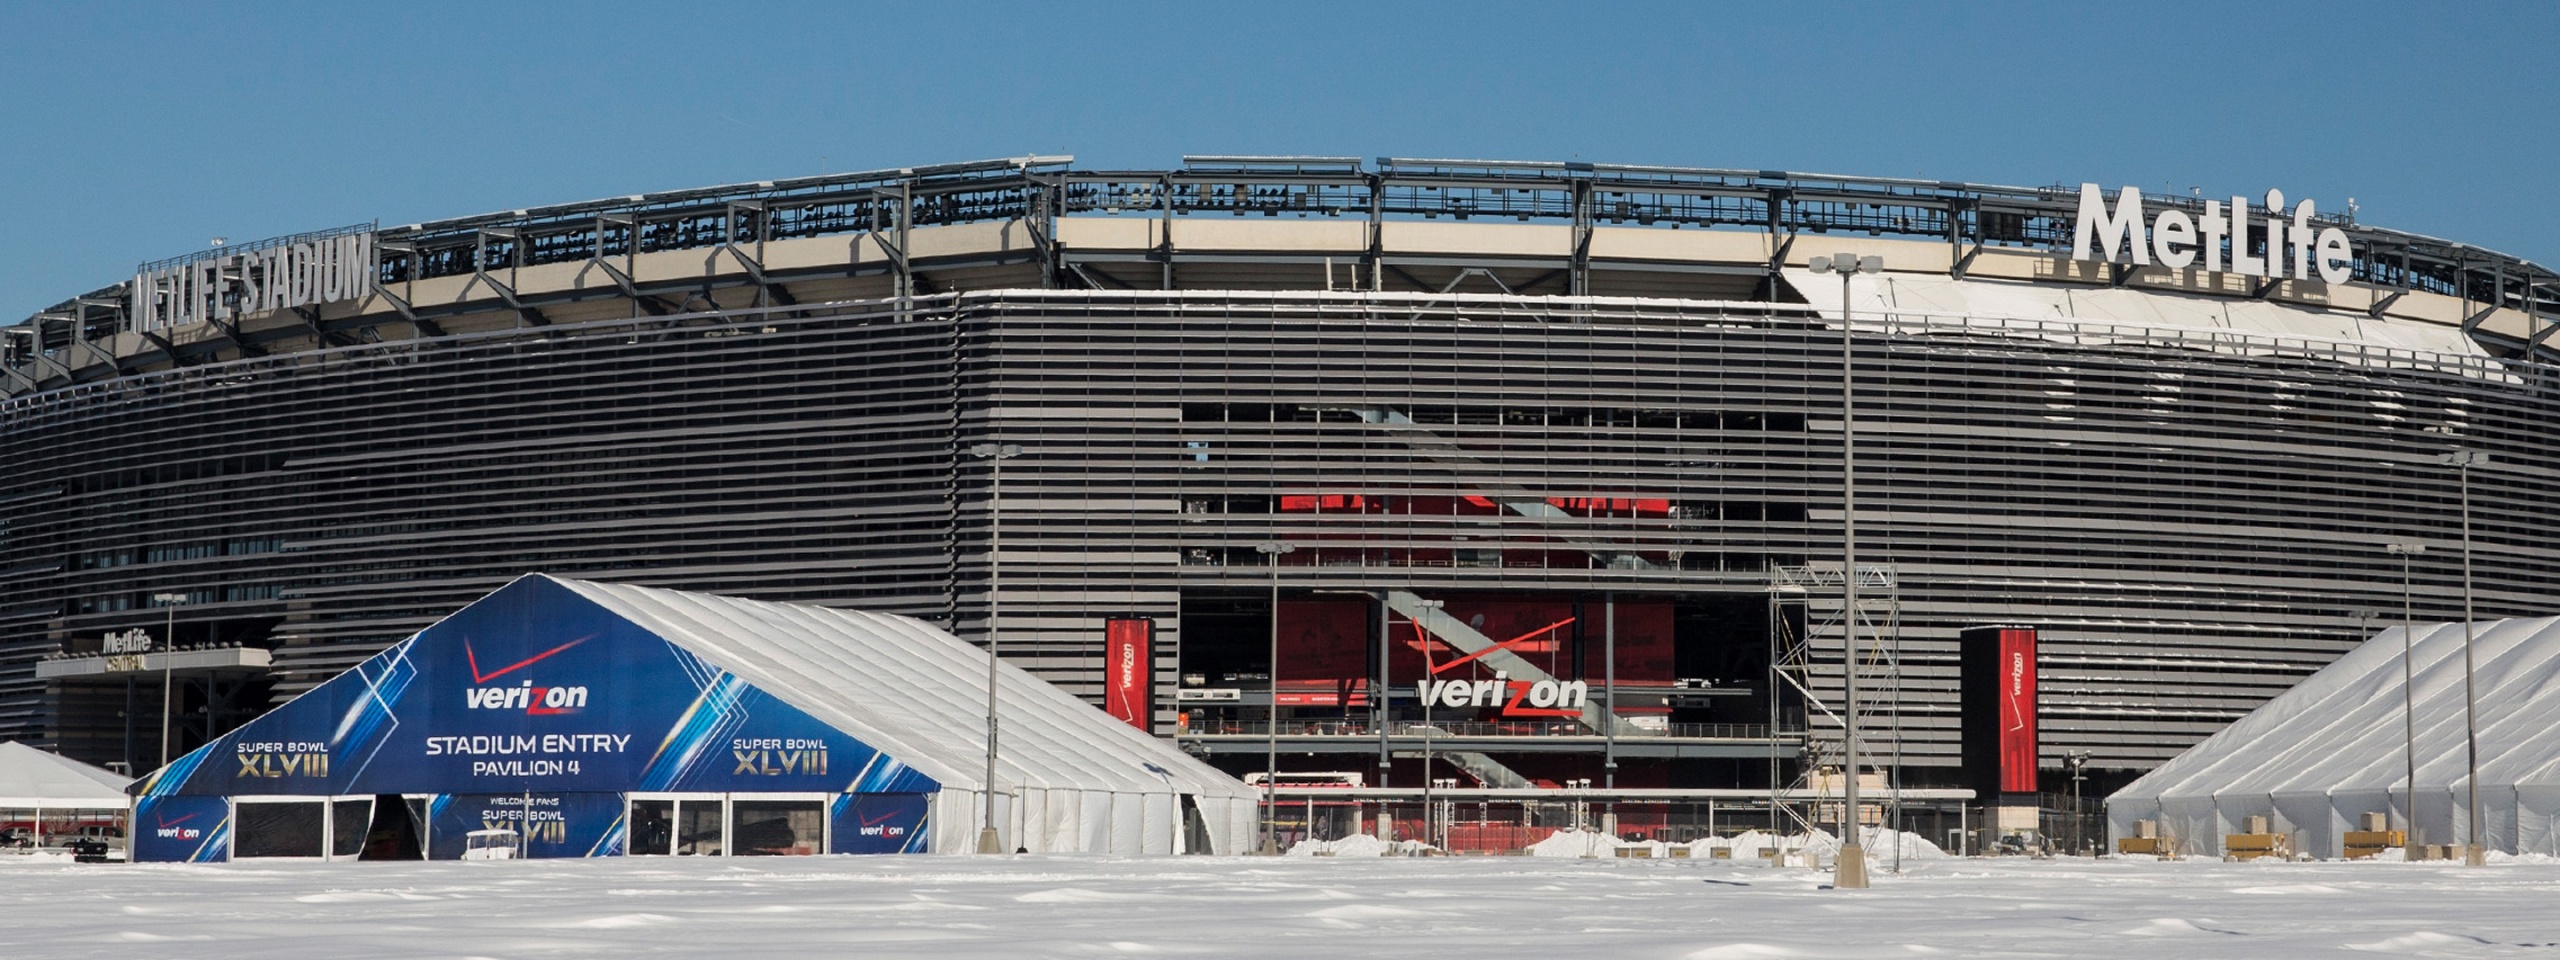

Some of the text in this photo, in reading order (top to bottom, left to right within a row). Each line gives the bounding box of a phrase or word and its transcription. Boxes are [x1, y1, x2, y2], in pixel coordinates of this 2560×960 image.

[2072, 182, 2353, 286] MetLife
[131, 232, 371, 335] METLIFE STADIUM
[103, 628, 151, 653] MetLife
[1123, 643, 1134, 689] verizon
[2011, 652, 2024, 696] verizon
[466, 679, 588, 715] verizon
[1417, 670, 1588, 716] verizon
[237, 742, 329, 753] SUPER BOWL
[425, 734, 632, 755] STADIUM ENTRY
[733, 739, 828, 749] SUPER BOWL
[237, 753, 329, 778] XLVIII
[473, 760, 580, 776] PAVILION 4
[733, 750, 828, 776] XLVIII
[536, 797, 560, 806] FANS
[482, 810, 566, 821] SUPER BOWL
[157, 826, 200, 840] verizon
[860, 824, 904, 838] verizon
